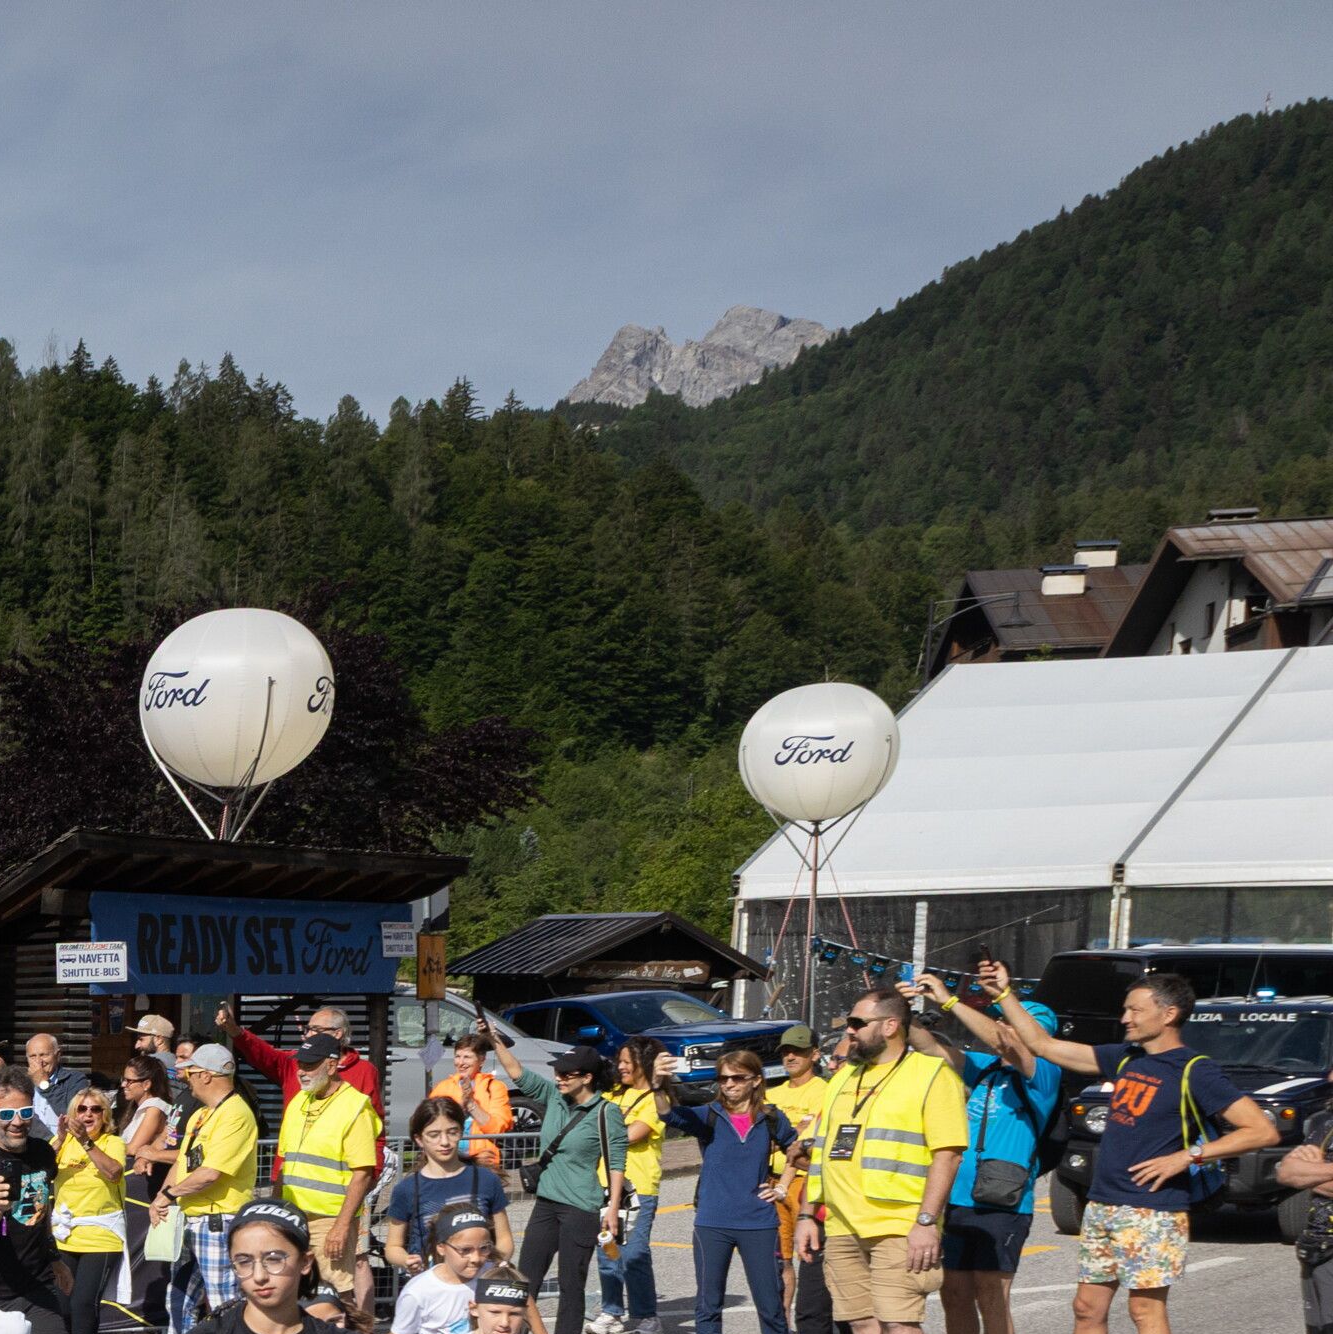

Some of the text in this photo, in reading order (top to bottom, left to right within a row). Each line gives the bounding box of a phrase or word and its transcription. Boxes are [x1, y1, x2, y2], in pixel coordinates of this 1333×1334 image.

[144, 671, 211, 712] Ford
[774, 735, 855, 766] Ford
[137, 912, 373, 976] READY SET Ford
[79, 953, 120, 964] NAVETTA
[62, 967, 120, 978] SHUTTLE-BUS
[1189, 1013, 1298, 1023] LIZIA LOCALE
[243, 1204, 302, 1227] FUGA
[485, 1287, 525, 1299] FUGA
